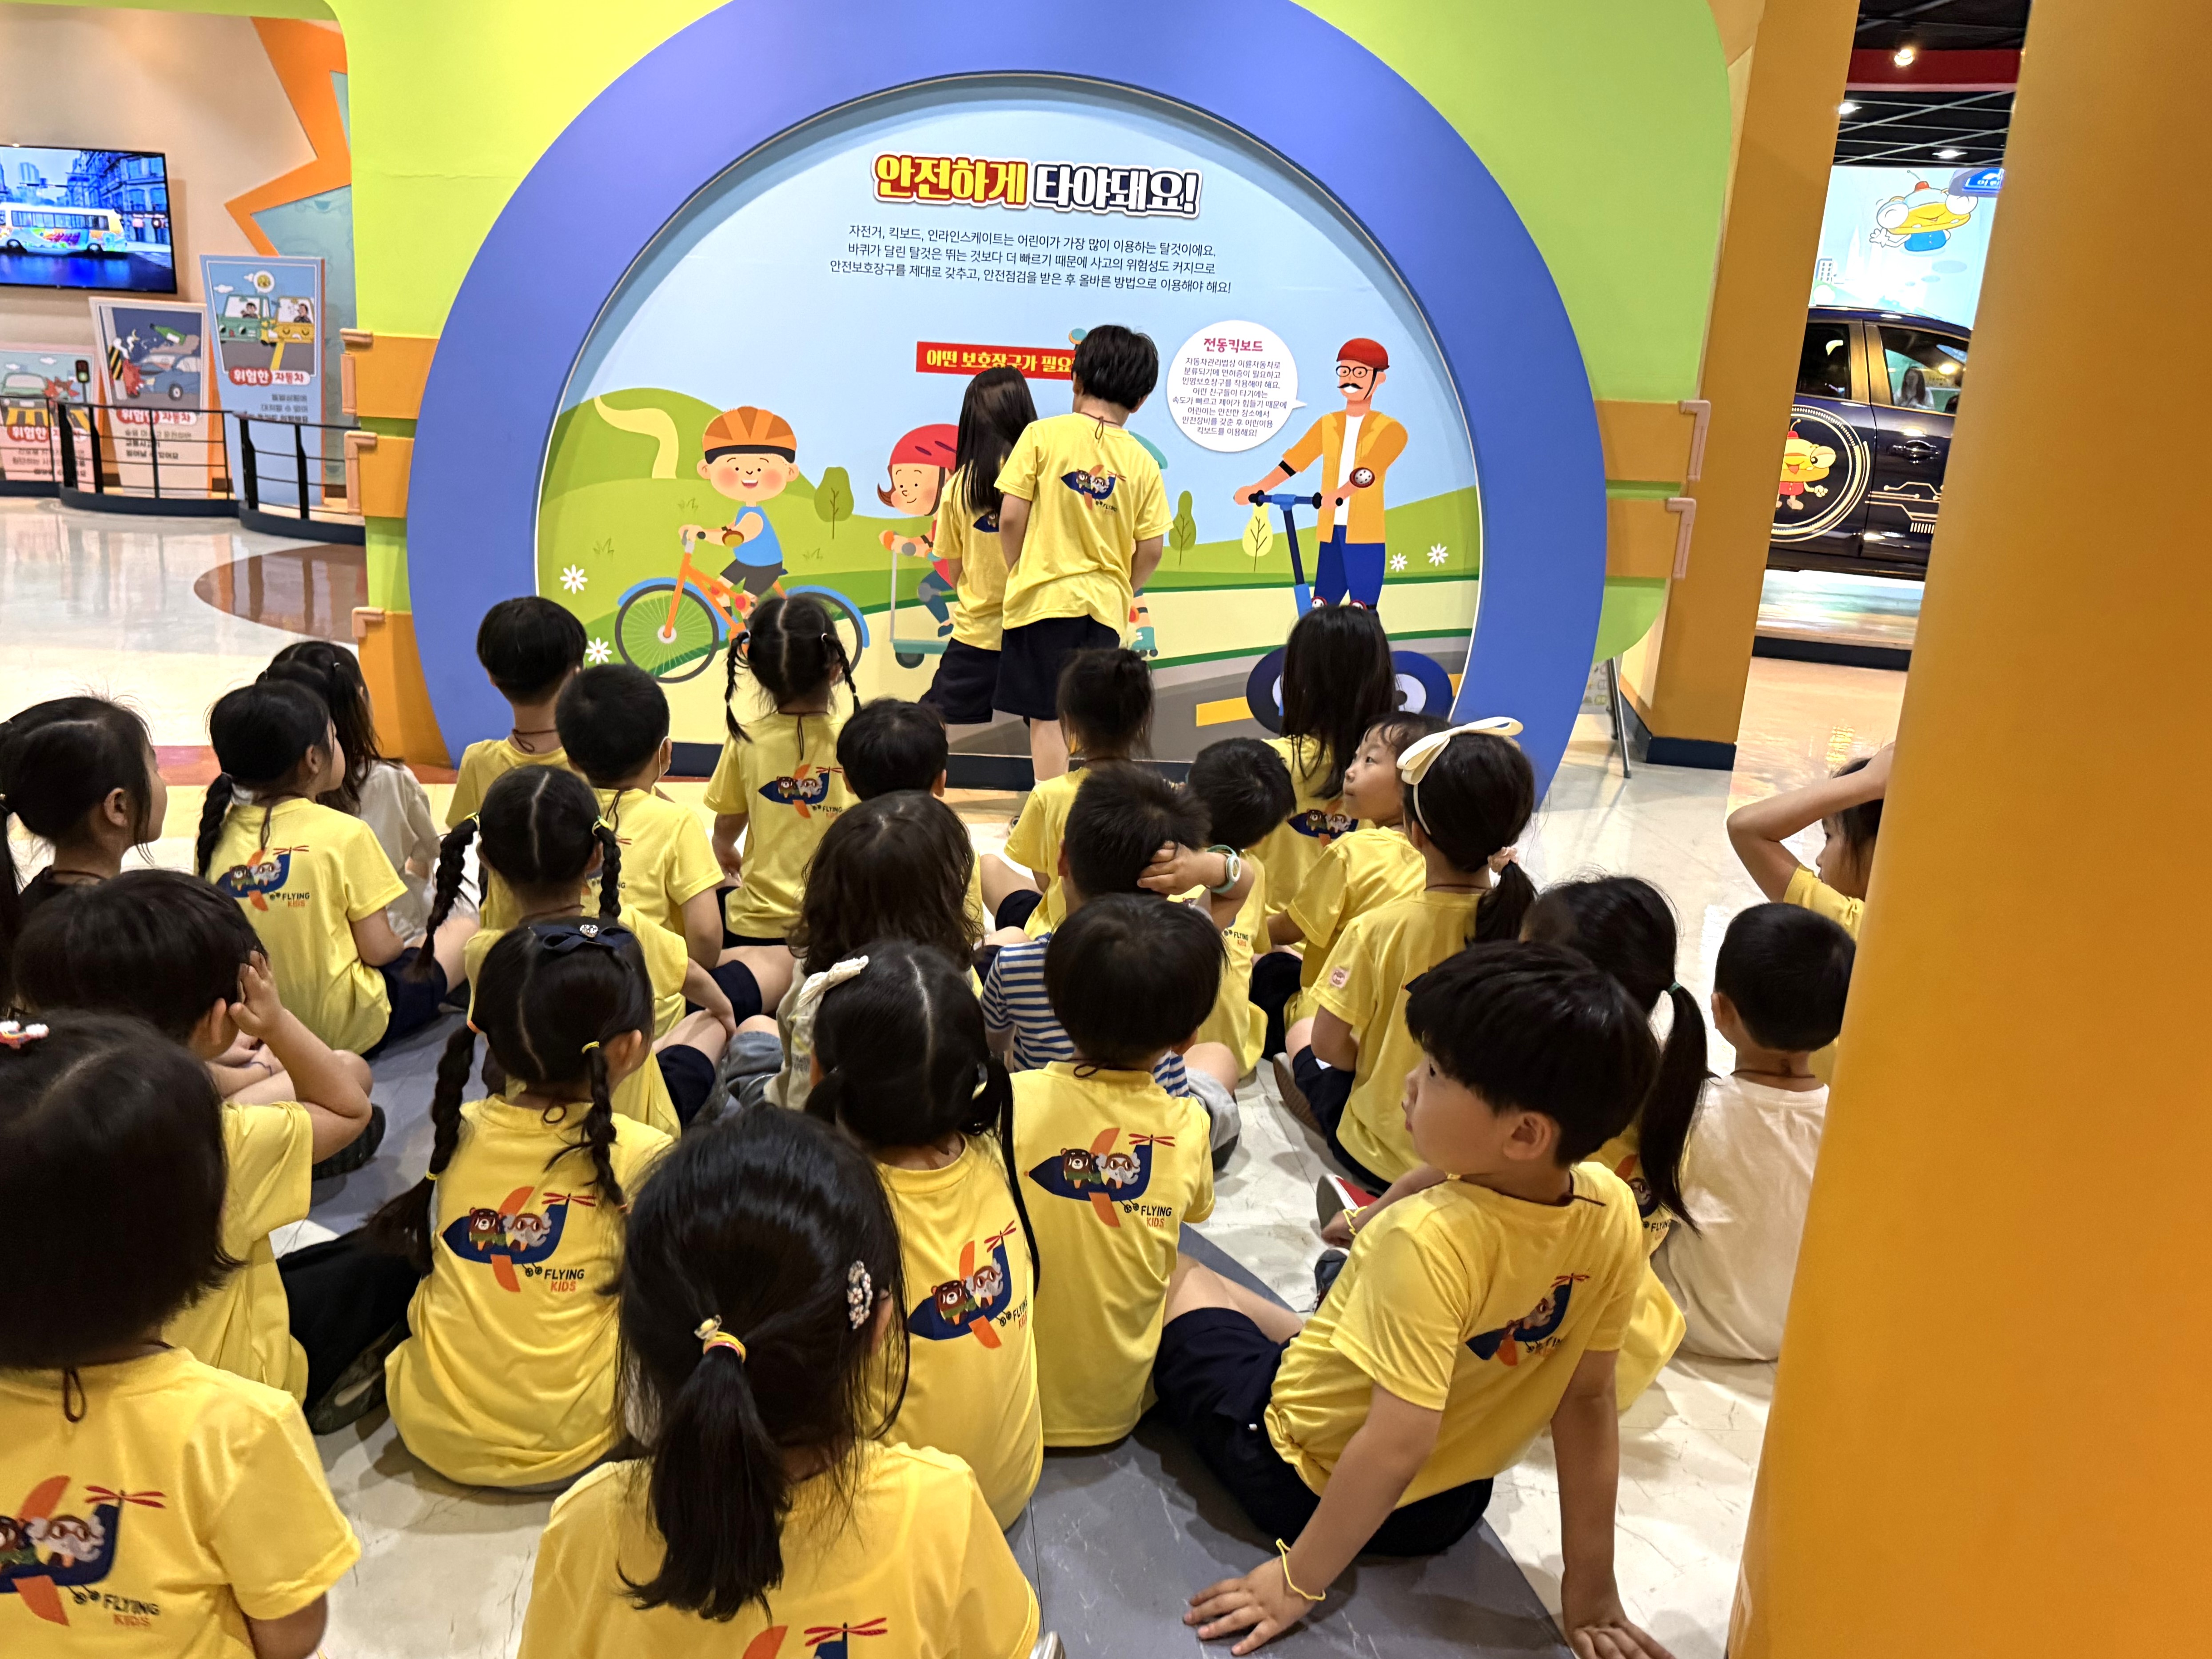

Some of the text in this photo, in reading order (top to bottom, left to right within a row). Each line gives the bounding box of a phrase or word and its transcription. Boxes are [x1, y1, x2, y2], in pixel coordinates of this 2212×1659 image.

[875, 155, 1200, 214] 안전하게 타야돼요!
[849, 225, 1216, 257] 자전거, 킥보드, 인라인스케이트는 어린이가 가장 많이 이용하는 탈것이에요.
[849, 243, 1215, 275] 바퀴가 달린 탈것은 뛰는 것보다 더 빠르기 때문에 사고의 위험성도 커지므로
[830, 260, 1231, 294] 안전보호장구를 제대로 갖추고, 안전점검을 받은 후 올바른 방법으로 이용해야 해요!
[1204, 338, 1263, 353] 전동킥보드
[926, 350, 1075, 373] 어떤 보호장구가 필요
[1185, 358, 1280, 369] 자동차관리법상 이륜자동차로
[233, 369, 269, 384] 위험한
[1184, 367, 1280, 379] 분류되기에 면허증이 필요하고
[1210, 388, 1237, 397] 친구들이
[1240, 390, 1268, 399] 타기에는
[1172, 396, 1193, 405] 속도가
[1243, 399, 1263, 408] 힘들기
[1266, 401, 1287, 409] 때문에
[1188, 407, 1270, 418] 어린이는 안전한 장소에서
[1182, 416, 1217, 425] 안전장비를
[1245, 419, 1273, 428] 어린이용
[1197, 427, 1257, 437] 킥보드를 이용해요!
[822, 806, 842, 814] FLYING
[282, 892, 310, 901] FLYING
[1141, 1205, 1172, 1216] FLYING
[1147, 1217, 1165, 1228] KIDS
[544, 1268, 585, 1280] FLYING
[550, 1280, 577, 1292] KIDS
[103, 1594, 160, 1616] FLYING
[113, 1614, 151, 1628] KIDS
